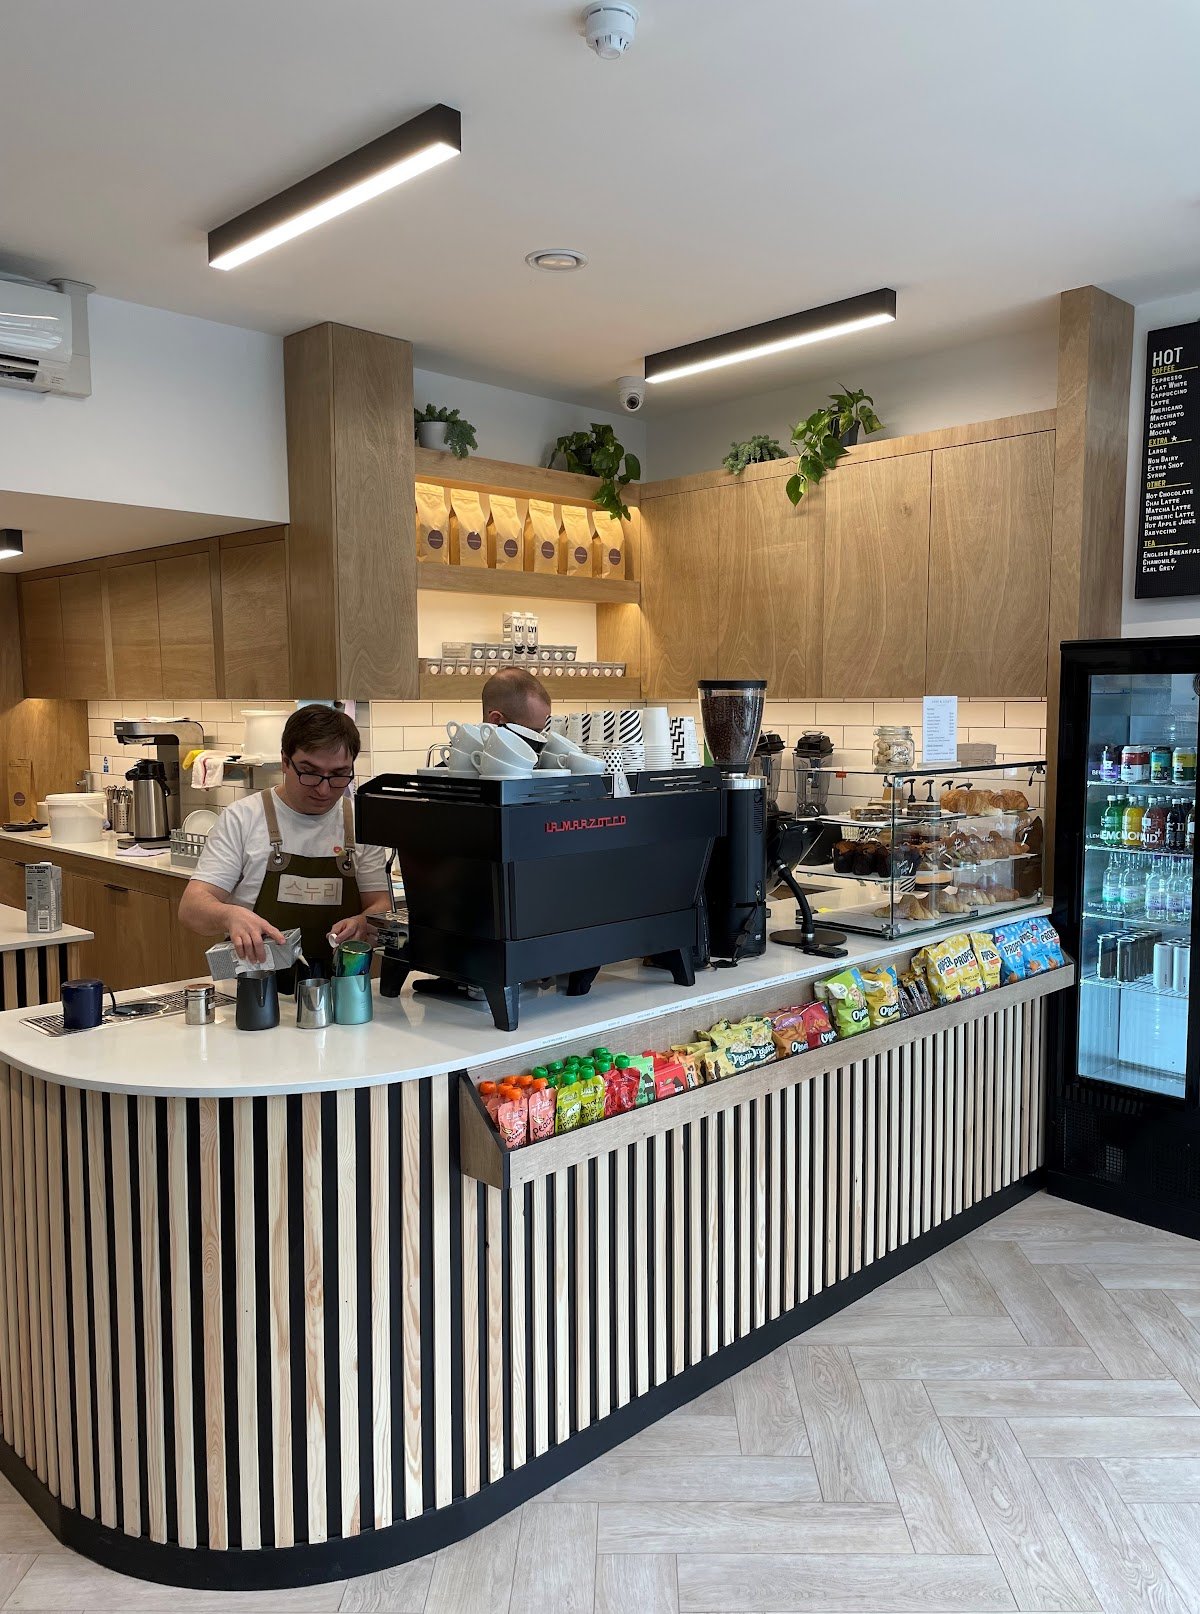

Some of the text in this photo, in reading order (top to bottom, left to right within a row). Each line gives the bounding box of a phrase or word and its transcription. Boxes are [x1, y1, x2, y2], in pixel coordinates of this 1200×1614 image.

[1152, 346, 1183, 368] HOT
[1152, 364, 1176, 375] COFFEE
[1152, 374, 1182, 384] ESPRESSO
[1151, 381, 1188, 392] FLAT WHITE
[1150, 388, 1188, 400] CAPPUCCINO
[1150, 398, 1170, 407] LATTE
[1150, 404, 1183, 414] AMERICANO
[1150, 412, 1184, 422] MACCHIATO
[1150, 420, 1176, 430] CORTADO
[1149, 428, 1170, 437] MOCHA
[1148, 436, 1168, 446] EXTRA
[1148, 448, 1168, 456] LARGE
[1148, 464, 1166, 472] EXTRA
[1147, 472, 1166, 480] SYRUP
[1146, 480, 1166, 489] OTHER
[1158, 488, 1194, 498] CHOCOLATE
[1160, 498, 1180, 506] LATTE
[1146, 504, 1191, 514] MATCHA LATTE
[1145, 510, 1194, 522] TURMERIC LATTE
[1144, 528, 1176, 536] BABYCCINO
[1142, 565, 1158, 573] EARL
[284, 880, 338, 902] 스누리
